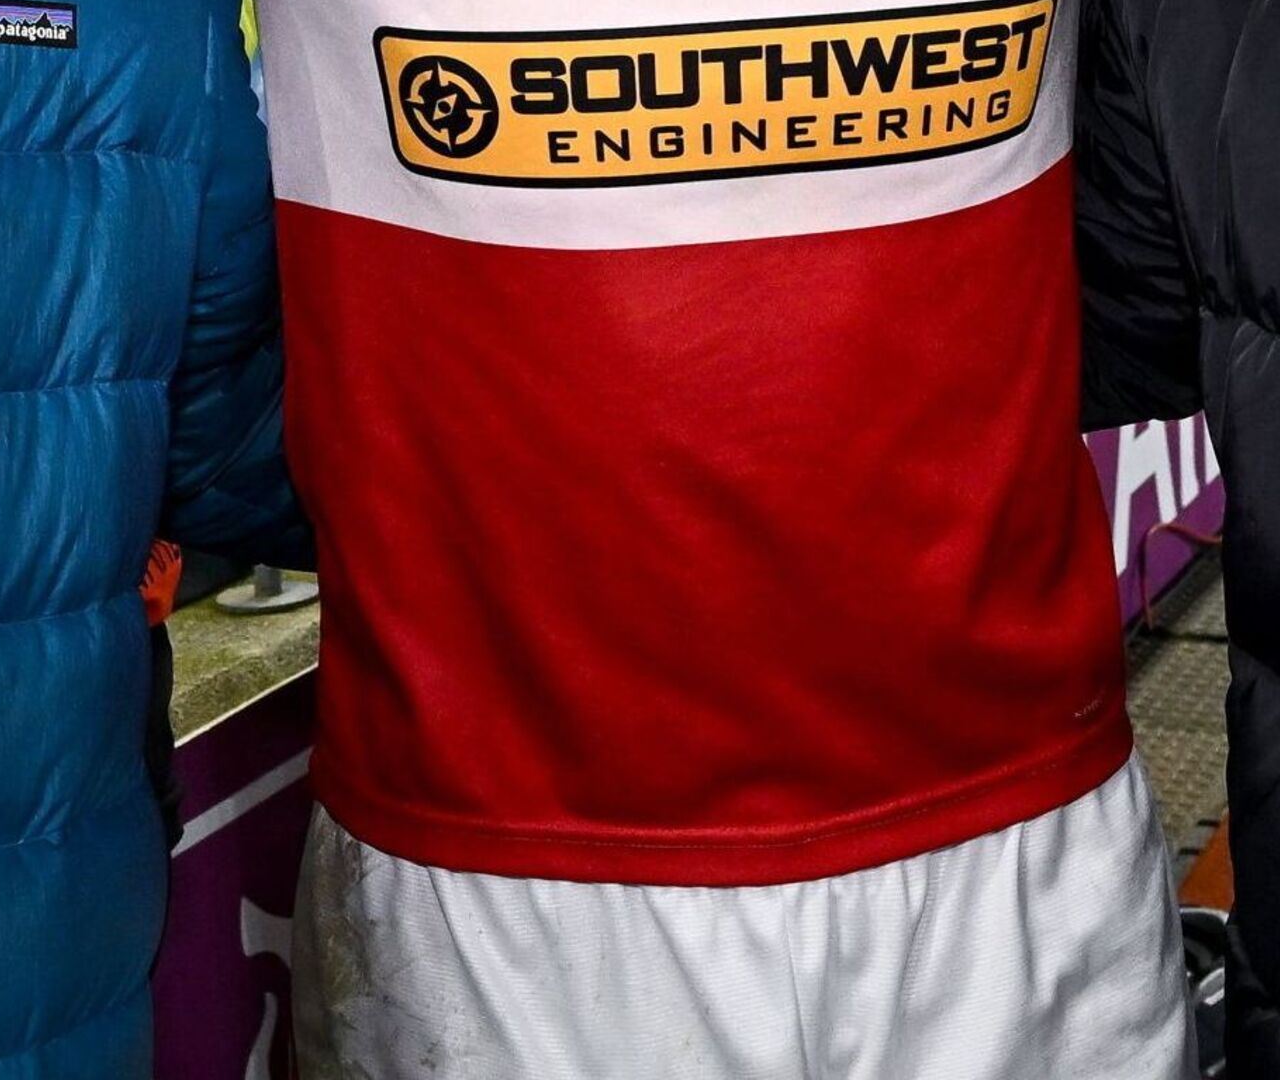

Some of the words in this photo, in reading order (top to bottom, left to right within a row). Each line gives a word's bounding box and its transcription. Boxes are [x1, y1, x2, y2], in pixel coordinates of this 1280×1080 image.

[509, 13, 1046, 115] SOUTHWEST
[547, 90, 1011, 164] ENGINEERING
[1113, 416, 1220, 577] AI
